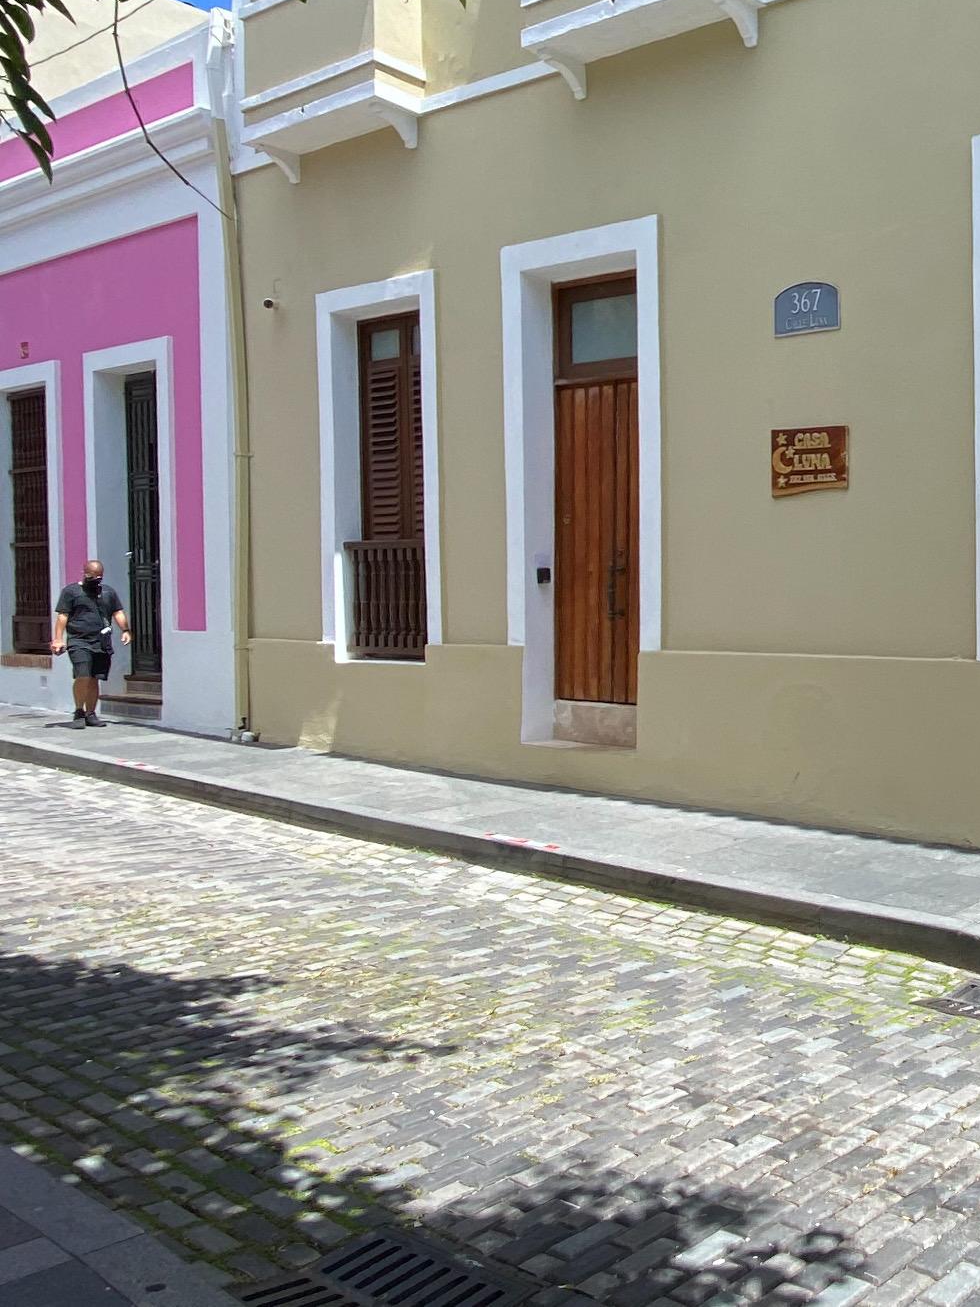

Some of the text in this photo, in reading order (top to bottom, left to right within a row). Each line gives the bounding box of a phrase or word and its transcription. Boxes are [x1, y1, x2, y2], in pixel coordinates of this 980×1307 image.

[791, 288, 821, 314] 367
[794, 432, 831, 449] CASA
[793, 453, 832, 470] LUNA
